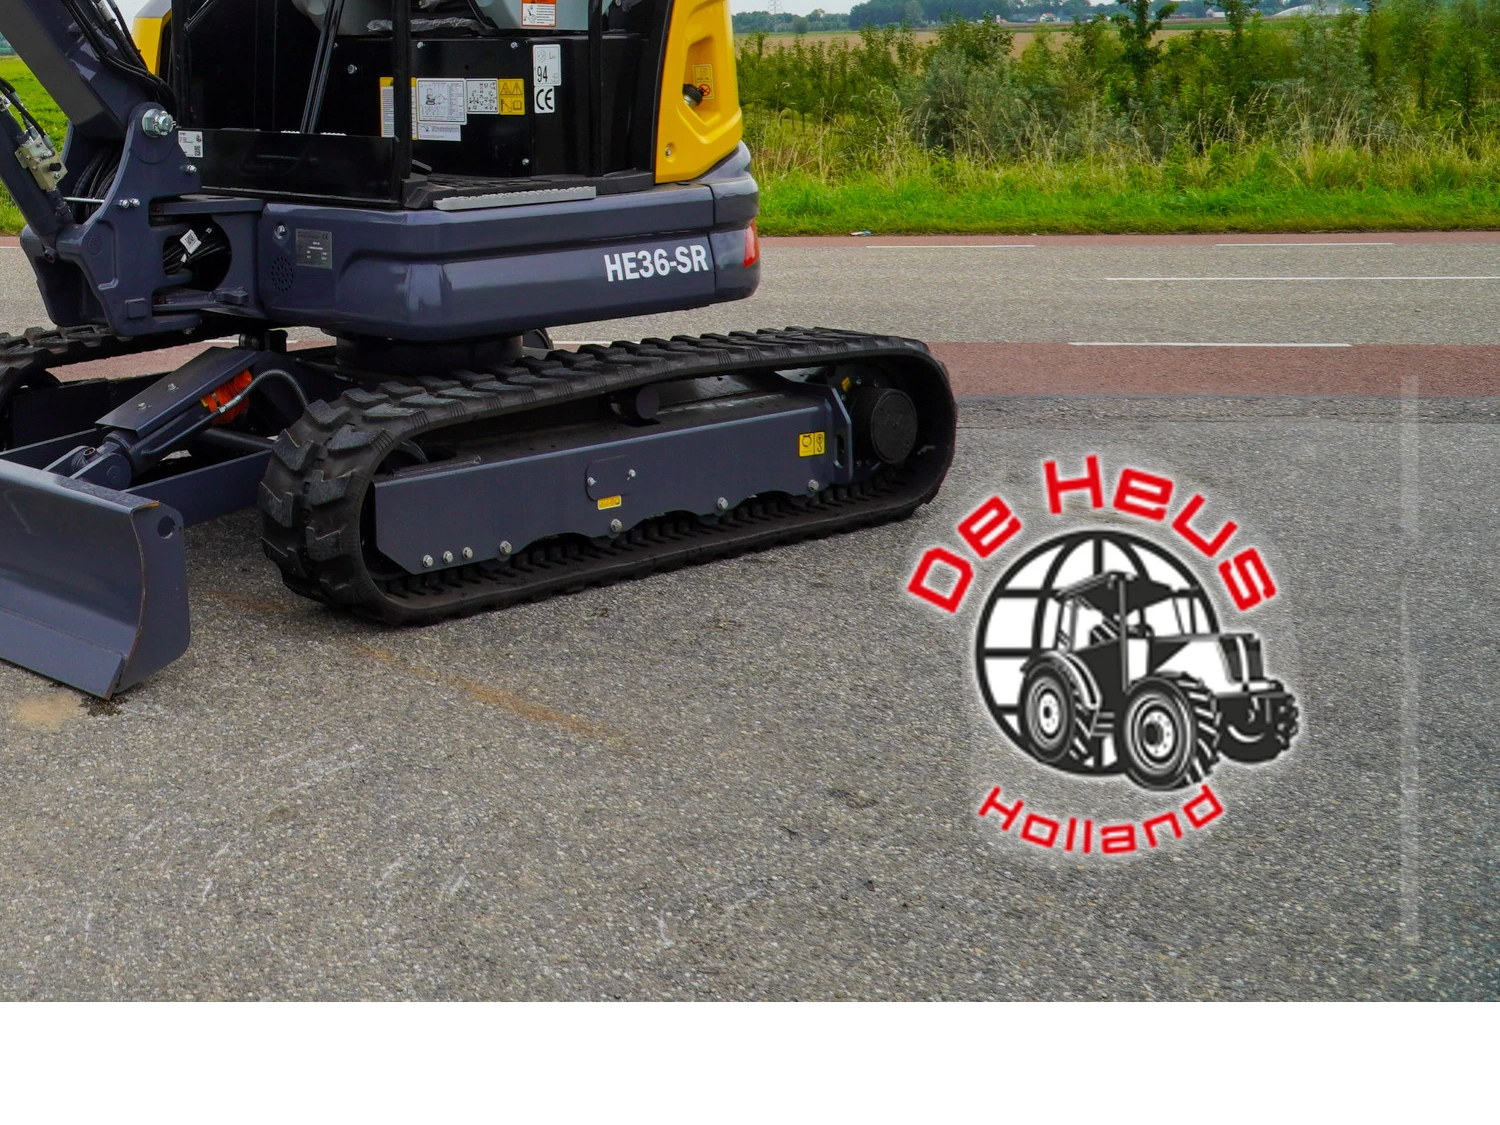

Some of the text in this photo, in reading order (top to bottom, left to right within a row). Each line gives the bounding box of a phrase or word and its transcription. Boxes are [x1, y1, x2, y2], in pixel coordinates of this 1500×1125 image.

[536, 65, 548, 83] 94
[536, 88, 554, 111] CE
[603, 244, 709, 282] HE36-SR
